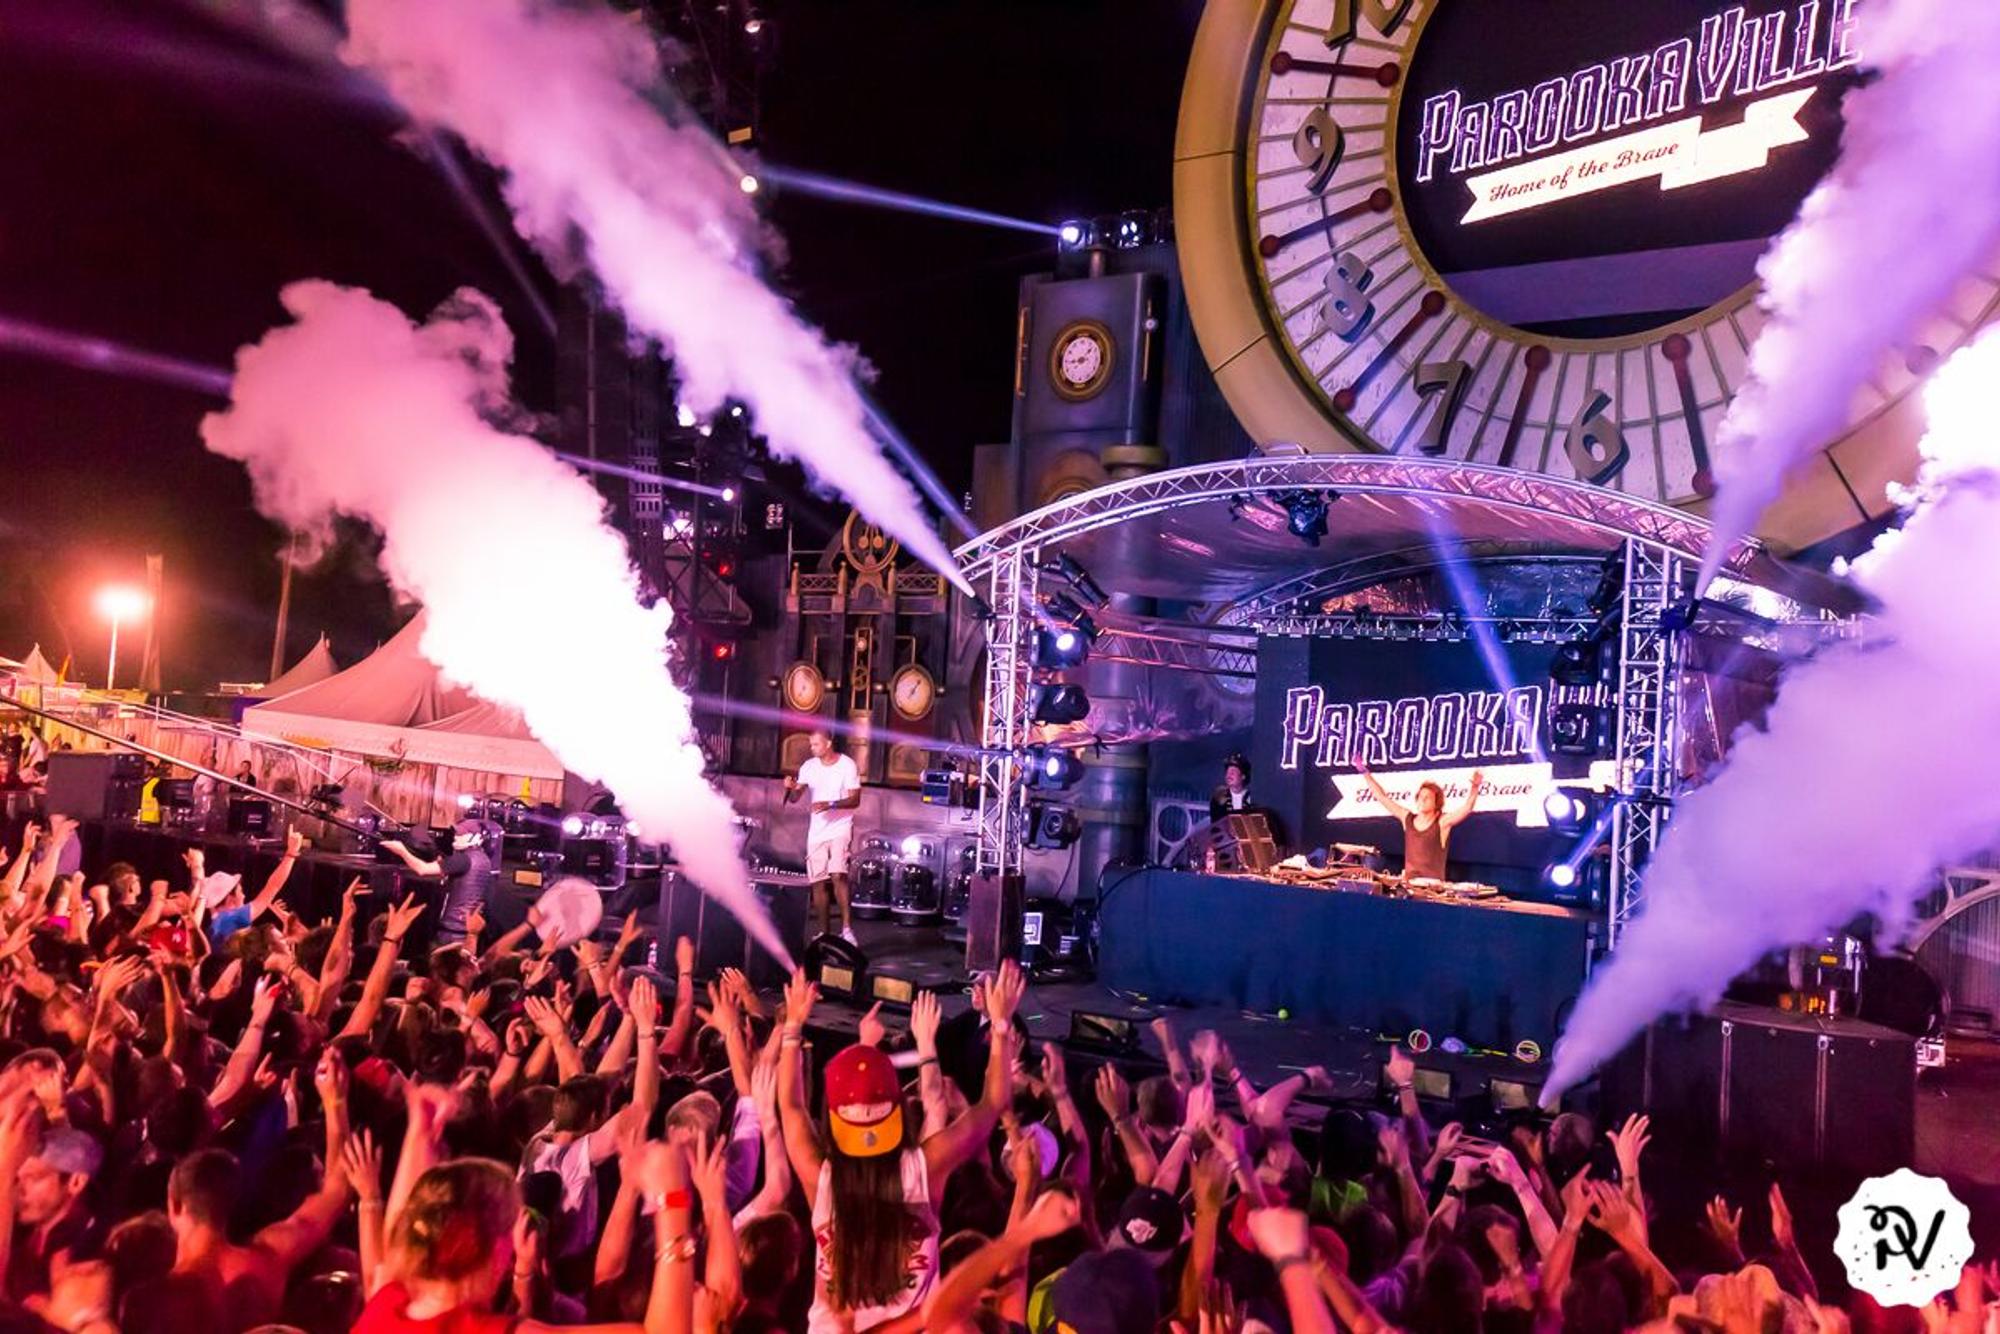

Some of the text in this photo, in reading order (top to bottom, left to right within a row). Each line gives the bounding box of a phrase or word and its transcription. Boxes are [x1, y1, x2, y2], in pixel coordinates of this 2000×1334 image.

[1293, 105, 1345, 195] 9
[1489, 143, 1679, 201] Home of the Brave
[1320, 252, 1376, 343] 8
[1412, 360, 1472, 456] 7
[1564, 388, 1630, 487] 6
[1356, 786, 1411, 804] Hme
[1477, 781, 1533, 797] Brave
